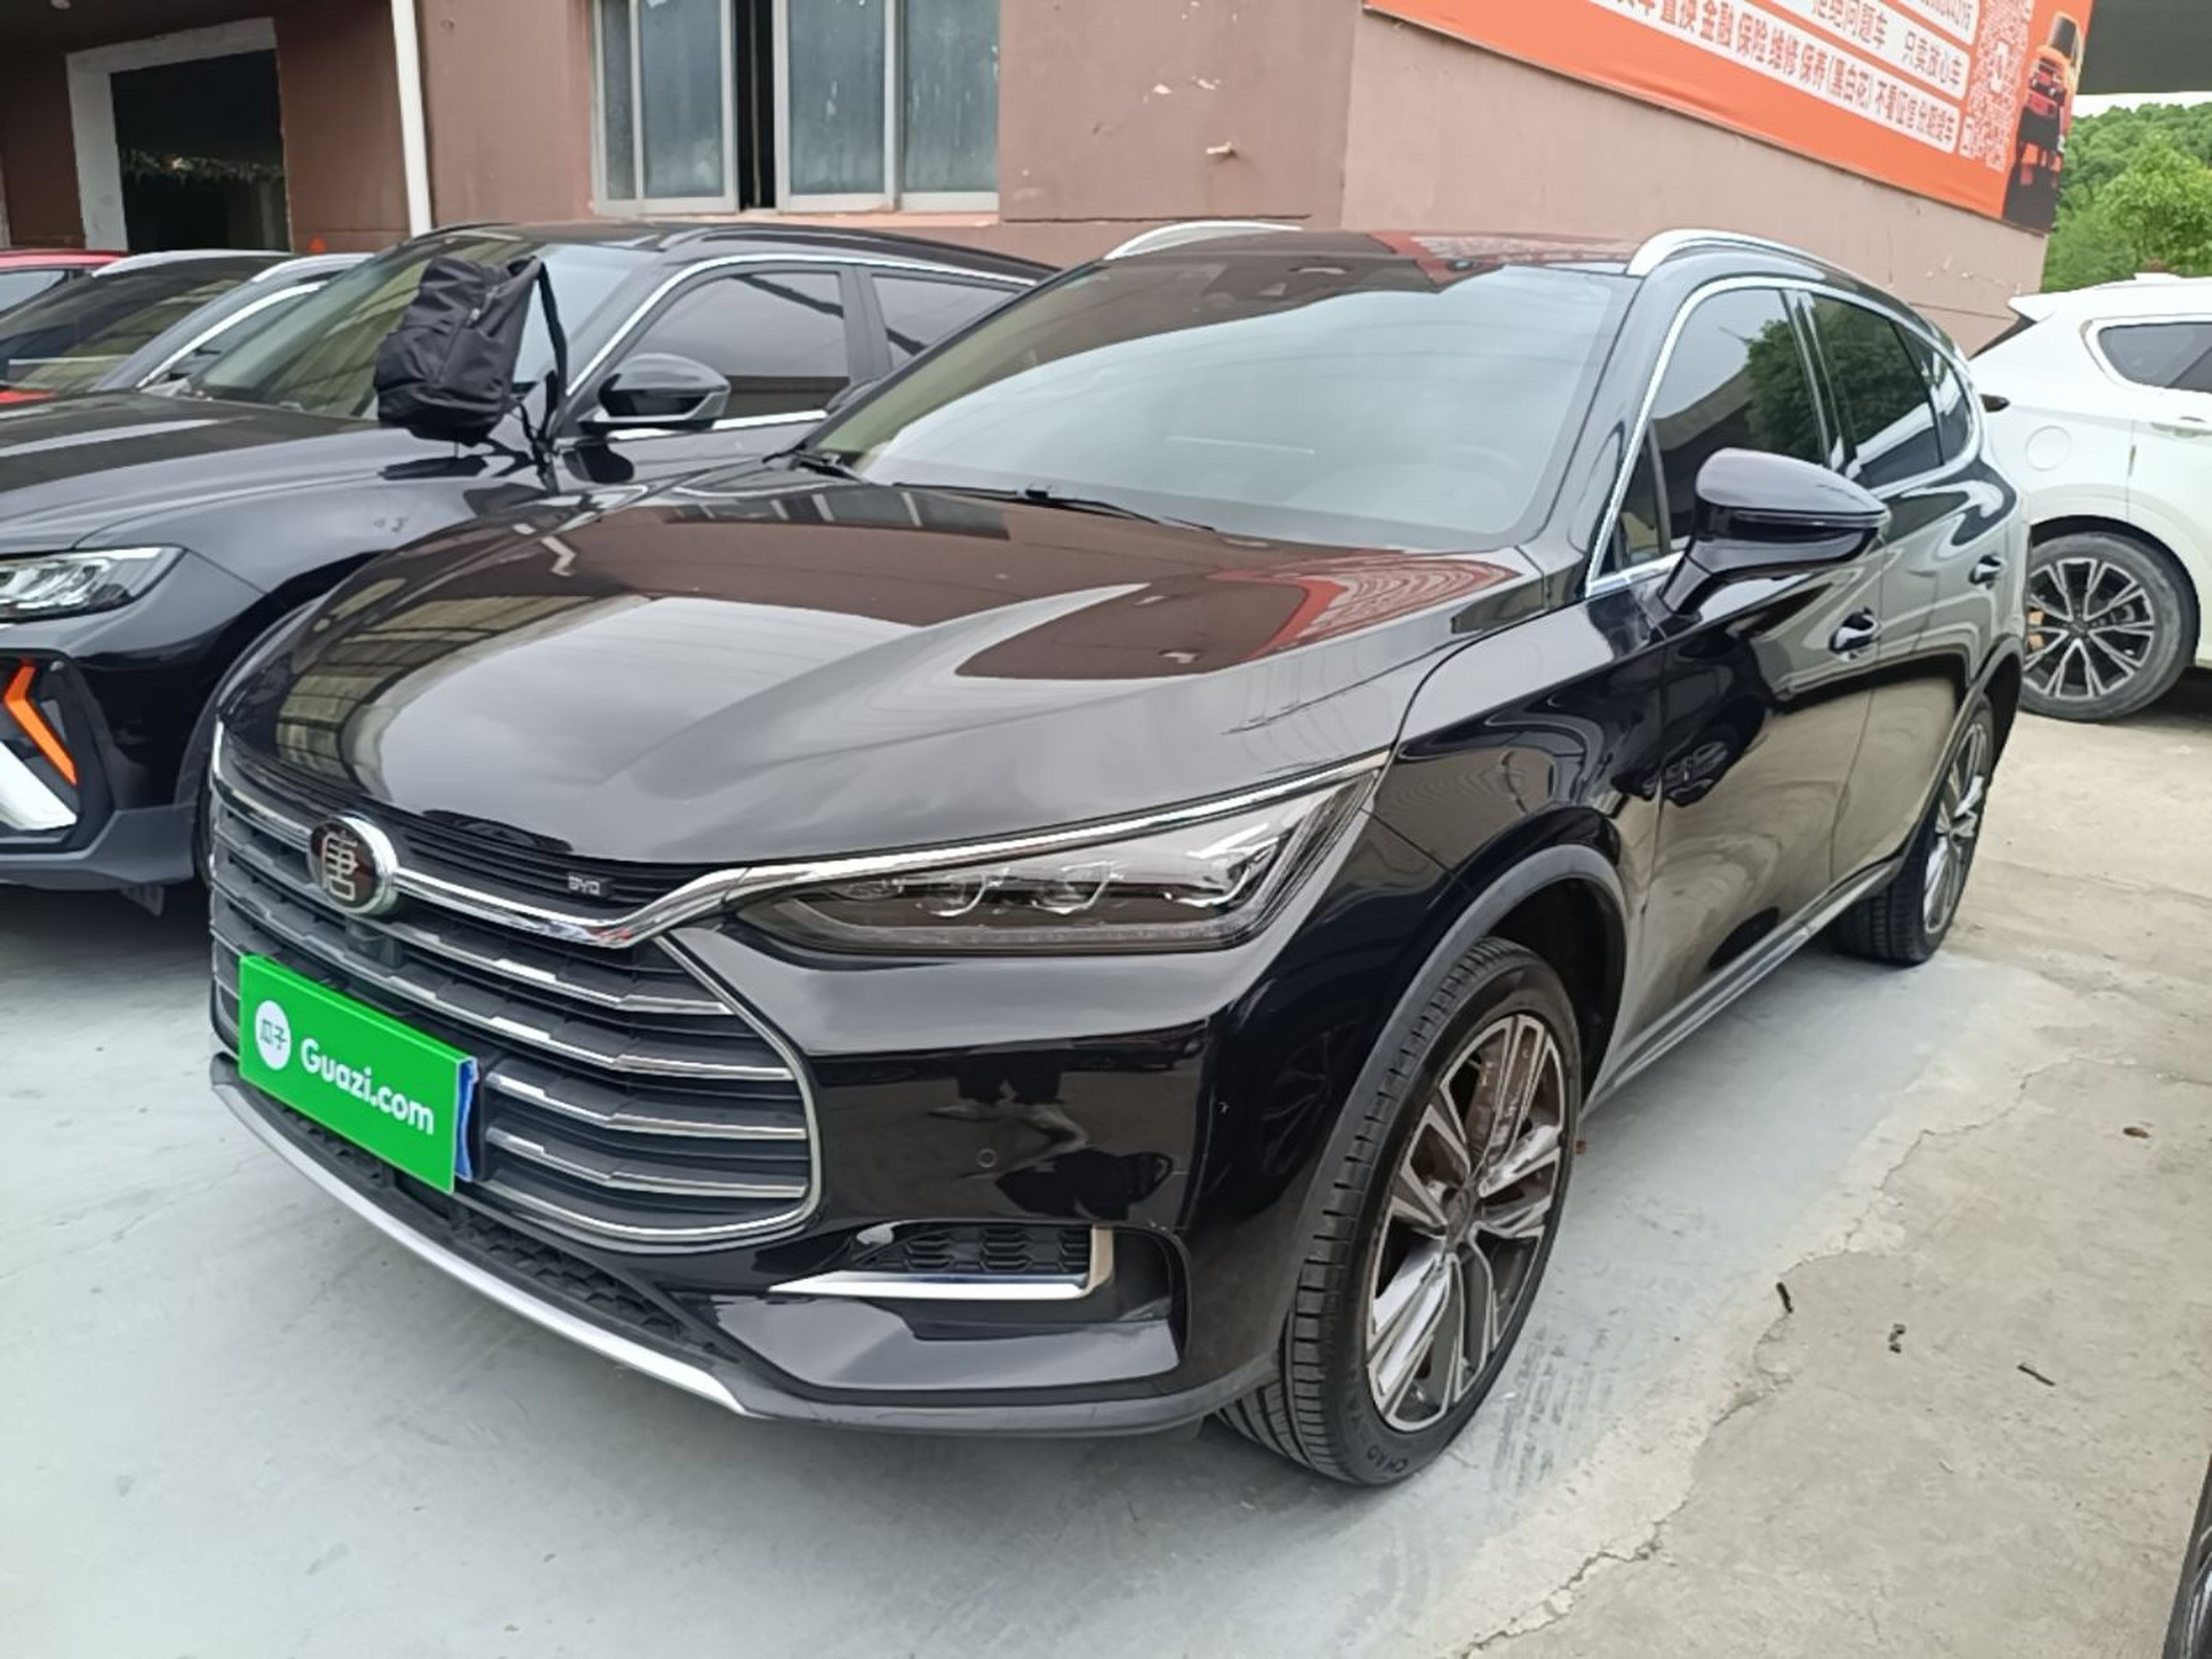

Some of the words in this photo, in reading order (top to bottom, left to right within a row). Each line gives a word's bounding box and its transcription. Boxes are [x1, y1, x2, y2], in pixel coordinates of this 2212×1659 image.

[1737, 12, 1767, 62] 保险
[1902, 30, 1962, 85] 只卖放心车
[323, 830, 358, 901] 唐
[569, 876, 600, 895] BYD
[301, 1037, 434, 1135] Guazi.com
